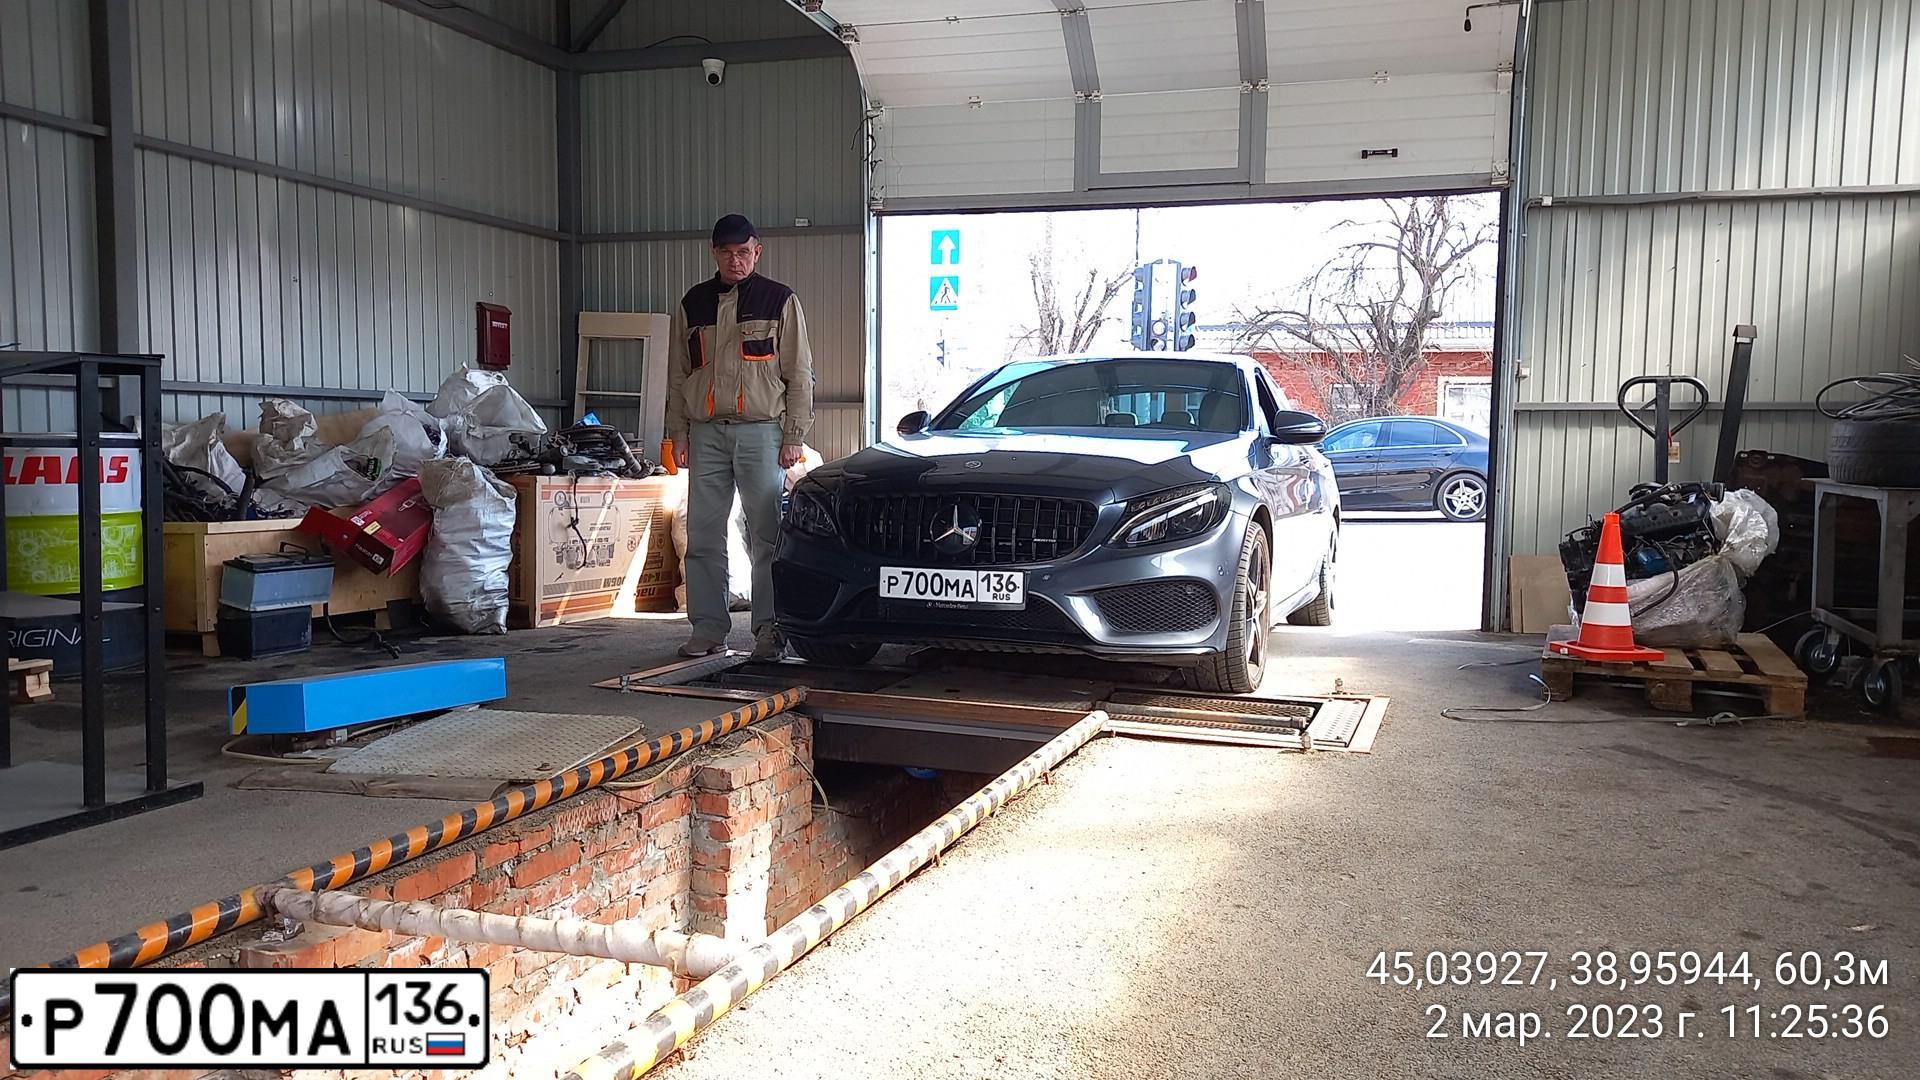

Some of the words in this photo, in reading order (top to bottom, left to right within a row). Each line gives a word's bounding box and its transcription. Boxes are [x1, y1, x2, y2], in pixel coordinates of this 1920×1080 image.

[3, 455, 129, 484] LAS
[887, 571, 975, 599] Р700МА
[981, 573, 1017, 593] 136
[992, 592, 1011, 601] RUS
[8, 627, 111, 648] RIGIN
